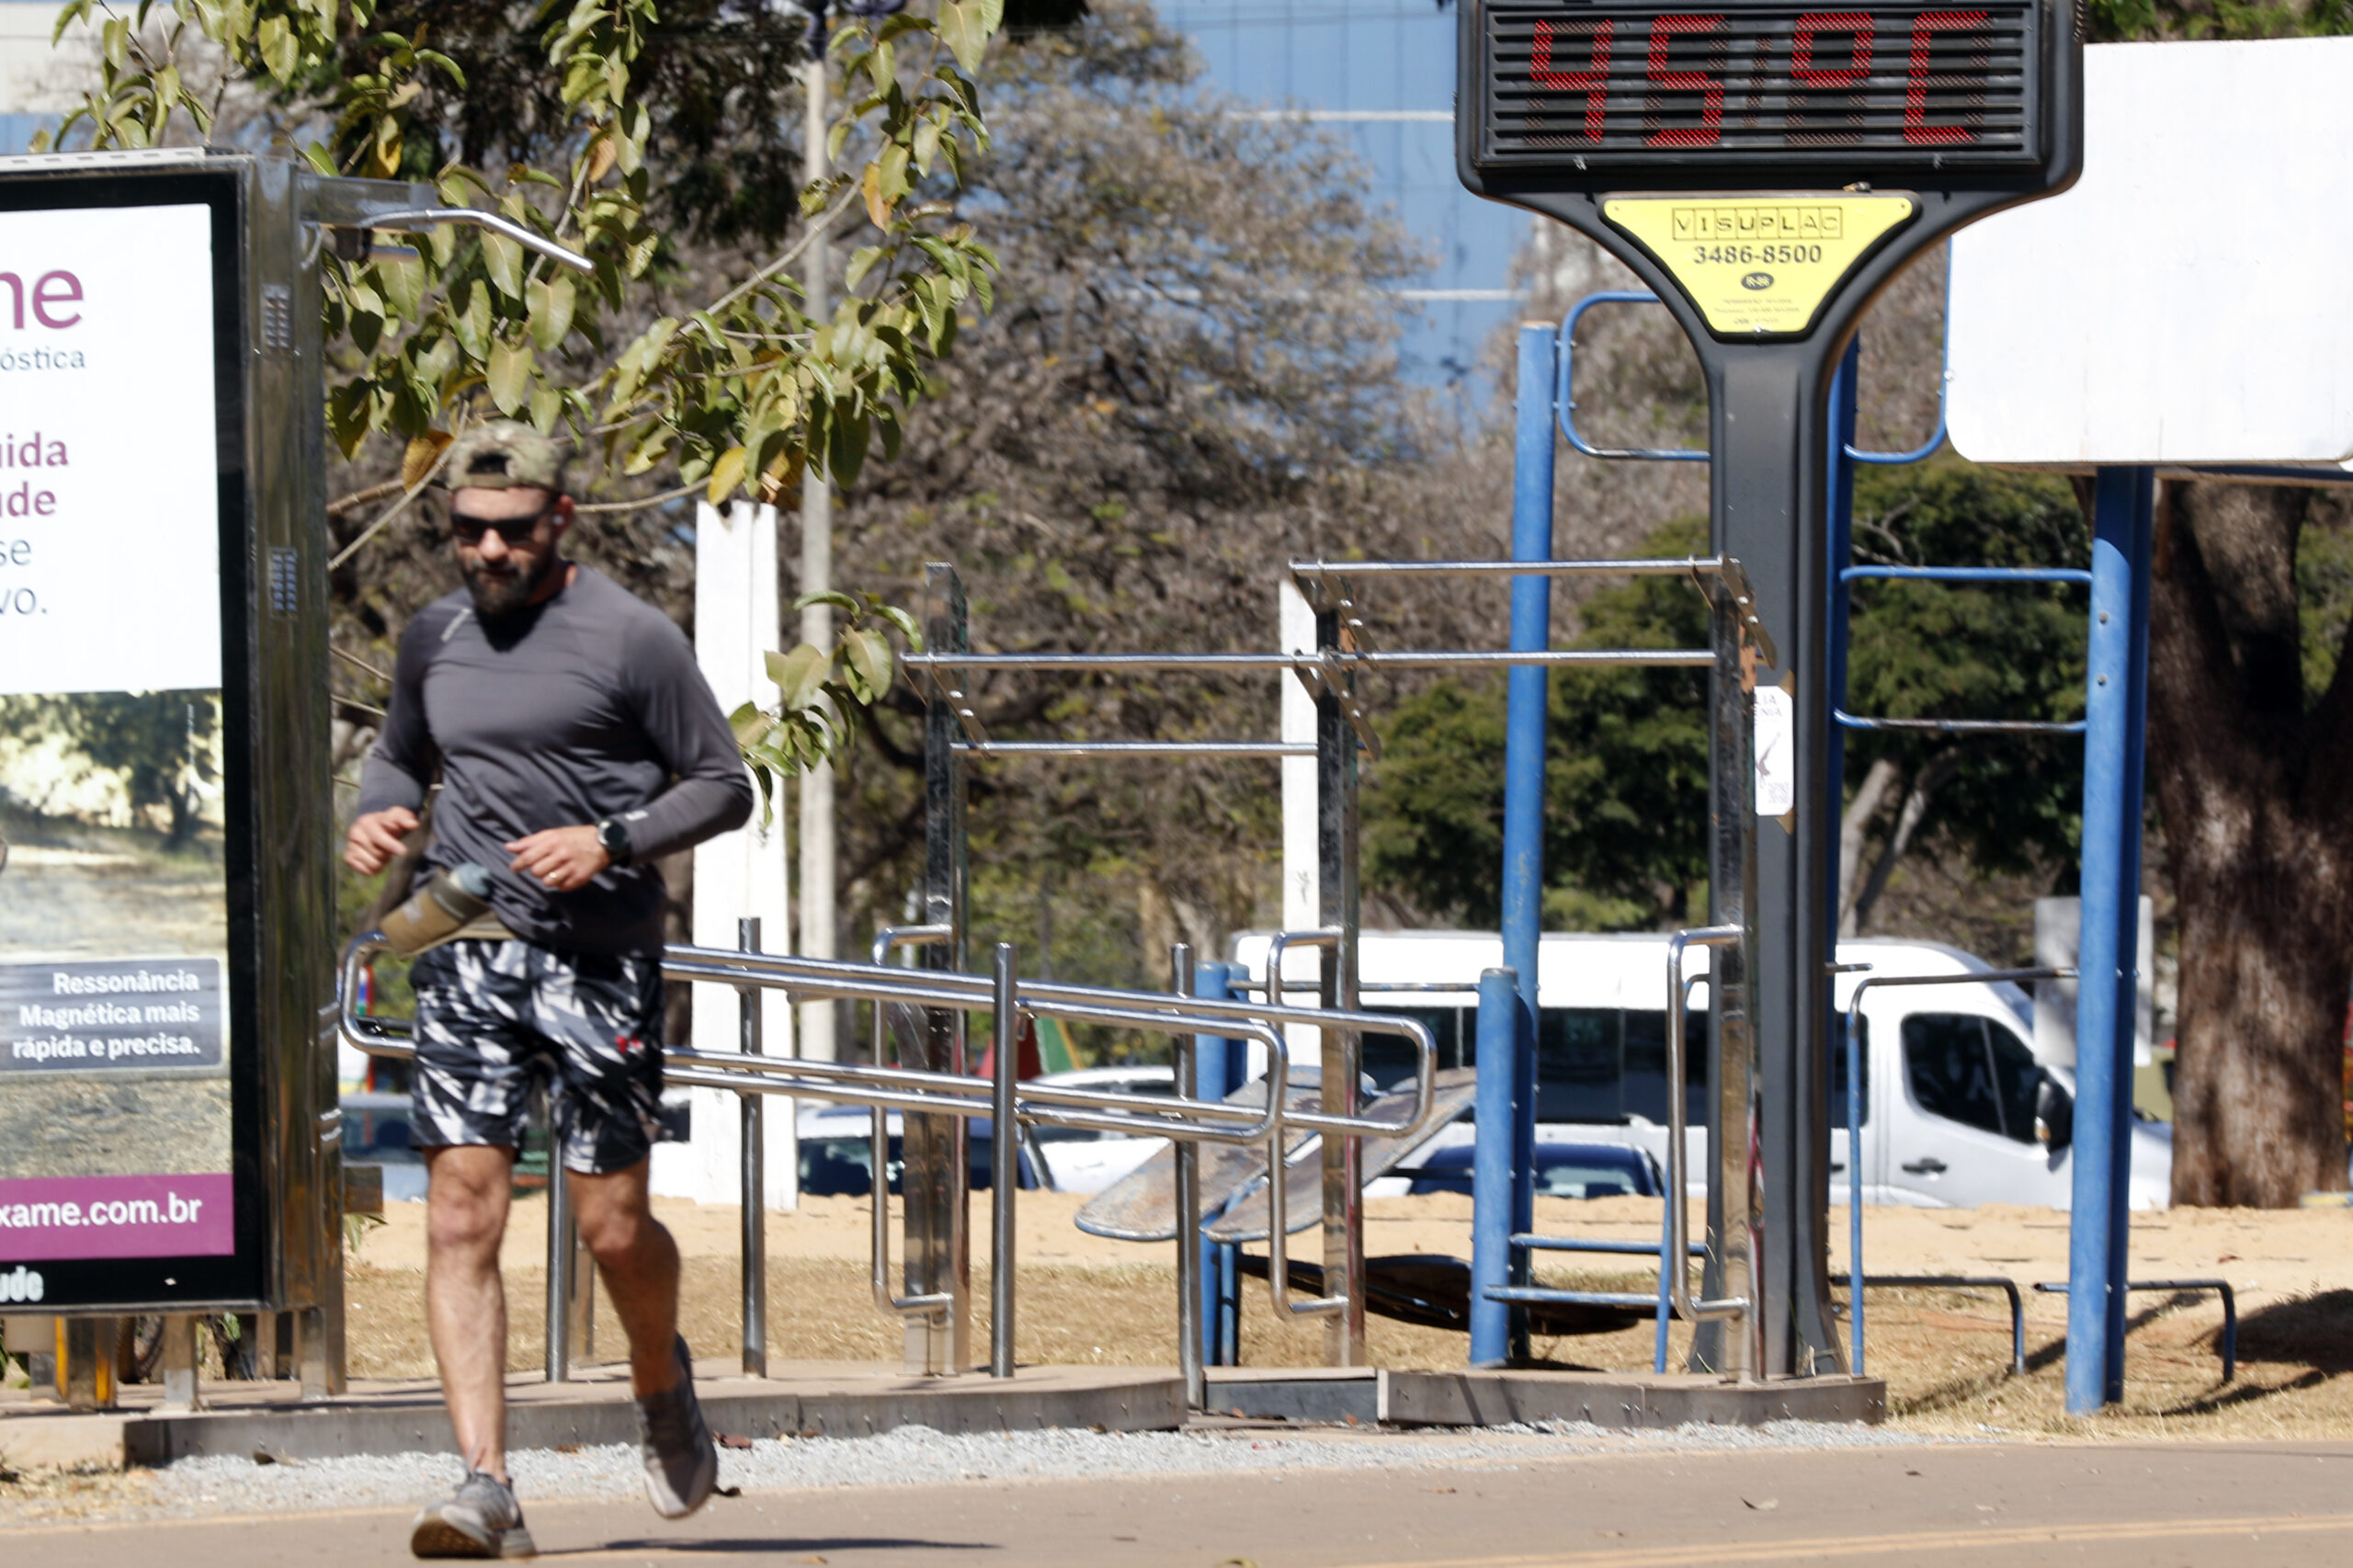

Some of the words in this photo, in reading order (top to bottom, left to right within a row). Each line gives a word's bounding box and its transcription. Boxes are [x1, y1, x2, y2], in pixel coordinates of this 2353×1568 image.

[1692, 244, 1823, 265] 3486-8500
[0, 430, 69, 468] ida
[0, 480, 57, 517] de
[52, 969, 200, 994] Ressonância
[18, 1002, 142, 1030] Magnética
[144, 1000, 200, 1023] mais
[12, 1034, 86, 1062] rápida
[88, 1039, 105, 1056] e
[108, 1032, 200, 1061] precisa.
